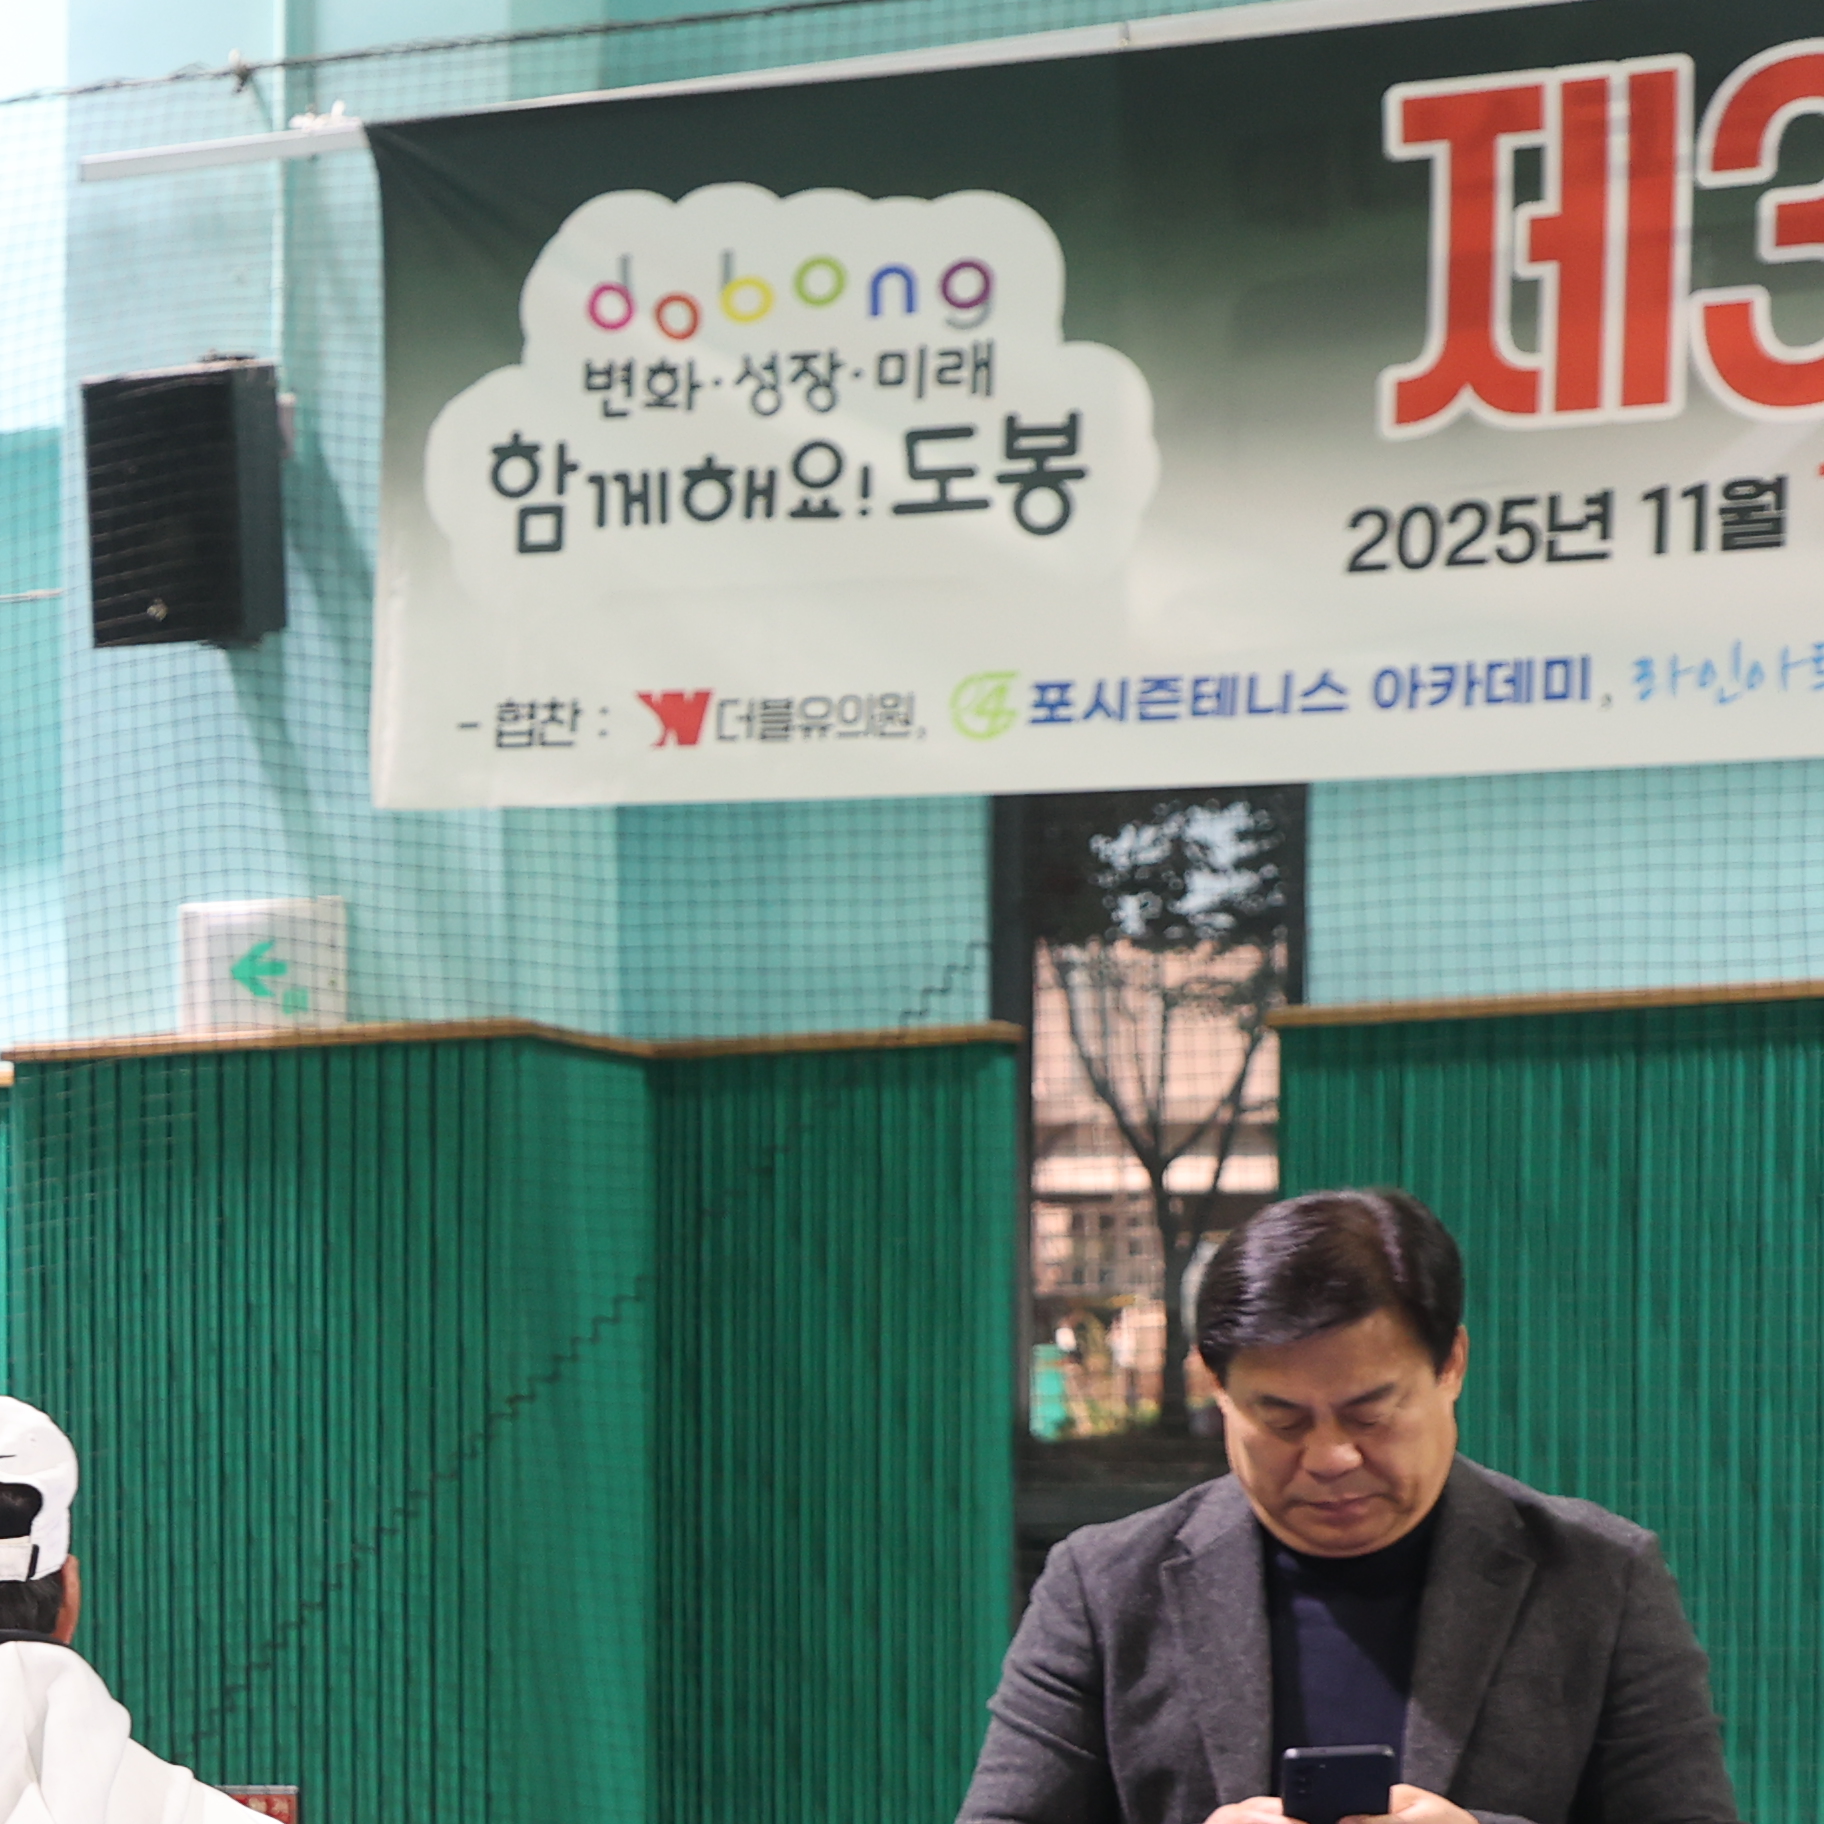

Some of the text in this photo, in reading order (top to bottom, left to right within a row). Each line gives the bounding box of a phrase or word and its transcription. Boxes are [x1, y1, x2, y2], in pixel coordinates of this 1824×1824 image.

[587, 251, 994, 338] dobong
[491, 413, 1086, 553] 함께해요! 도봉
[1345, 475, 1788, 572] 2025년 11월
[1028, 667, 1350, 727] 포시즌테니스
